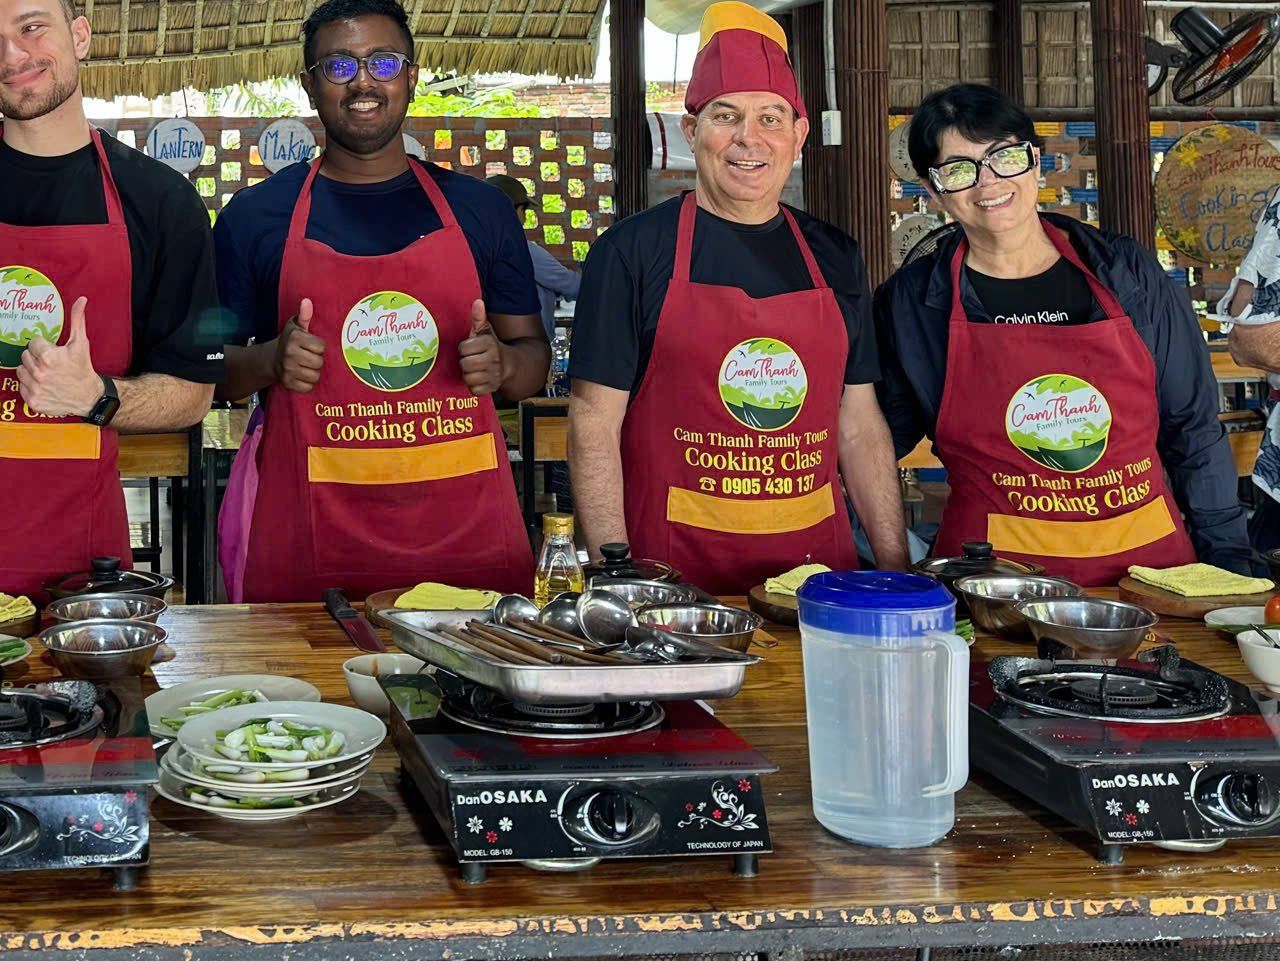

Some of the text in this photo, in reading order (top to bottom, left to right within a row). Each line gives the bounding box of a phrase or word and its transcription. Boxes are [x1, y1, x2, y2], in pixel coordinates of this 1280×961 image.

[21, 312, 41, 321] Tours
[1037, 310, 1069, 323] Klein
[368, 333, 417, 347] Family Tours
[745, 379, 768, 388] Family
[315, 395, 479, 418] Cam Thanh Family Tours
[326, 416, 474, 443] Cooking Class
[1036, 416, 1088, 431] Family Tours
[673, 427, 828, 450] Cam Thanh Family Tours
[685, 447, 822, 476] Cooking Class
[992, 472, 1026, 487] Cam
[1075, 469, 1123, 489] Family
[1125, 457, 1152, 478] Tours
[722, 473, 815, 495] 0905 430 137
[1008, 480, 1151, 516] Cooking Class
[1092, 772, 1180, 789] DanOSAKA
[457, 789, 549, 806] DanOSAKA
[687, 840, 764, 849] TECHNOLOGY OF JAPAN
